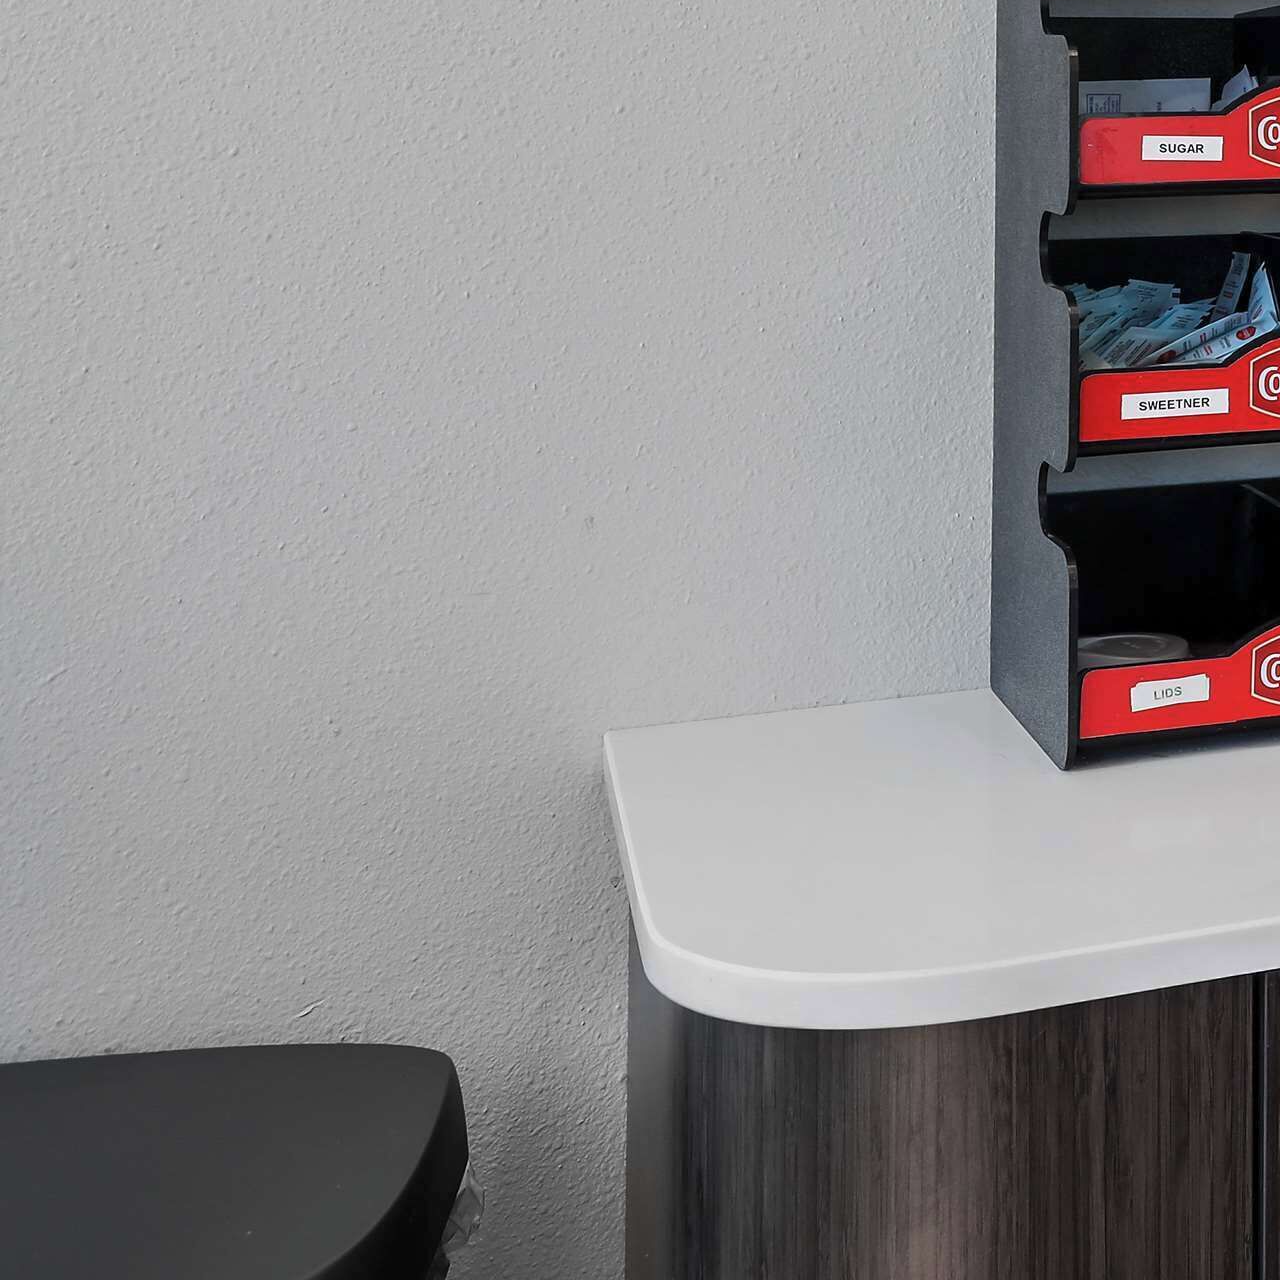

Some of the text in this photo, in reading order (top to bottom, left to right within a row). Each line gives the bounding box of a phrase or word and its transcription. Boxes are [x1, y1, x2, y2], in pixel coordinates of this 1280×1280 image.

[1159, 144, 1204, 154] SUGAR
[1139, 397, 1210, 412] SWEETNER
[1154, 686, 1182, 700] LIDS
